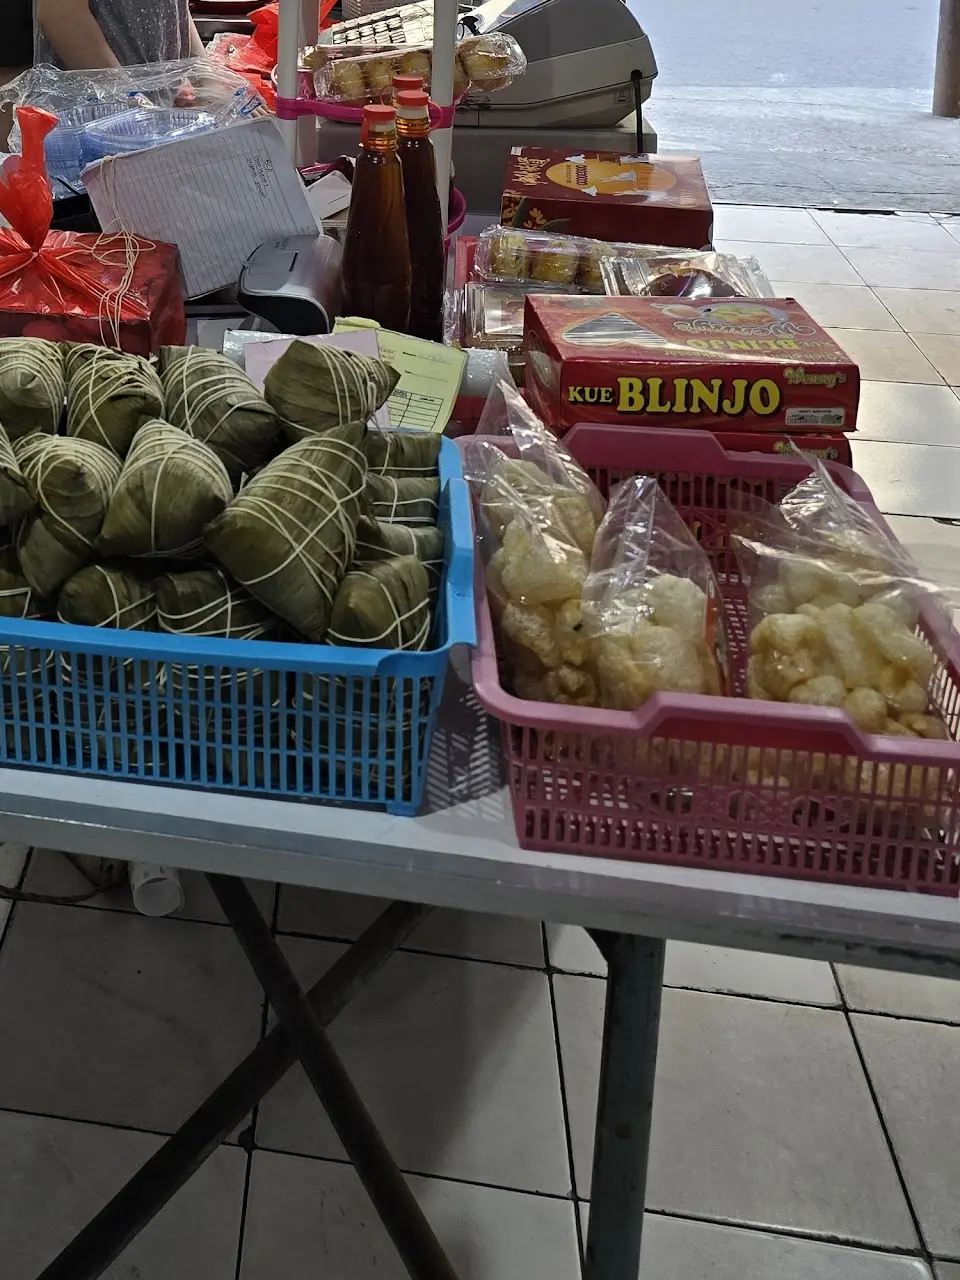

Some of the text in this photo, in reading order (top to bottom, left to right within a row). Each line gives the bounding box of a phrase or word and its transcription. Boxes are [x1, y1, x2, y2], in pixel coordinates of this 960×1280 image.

[686, 339, 798, 350] BLINJO
[568, 376, 781, 416] KUE BLINJO
